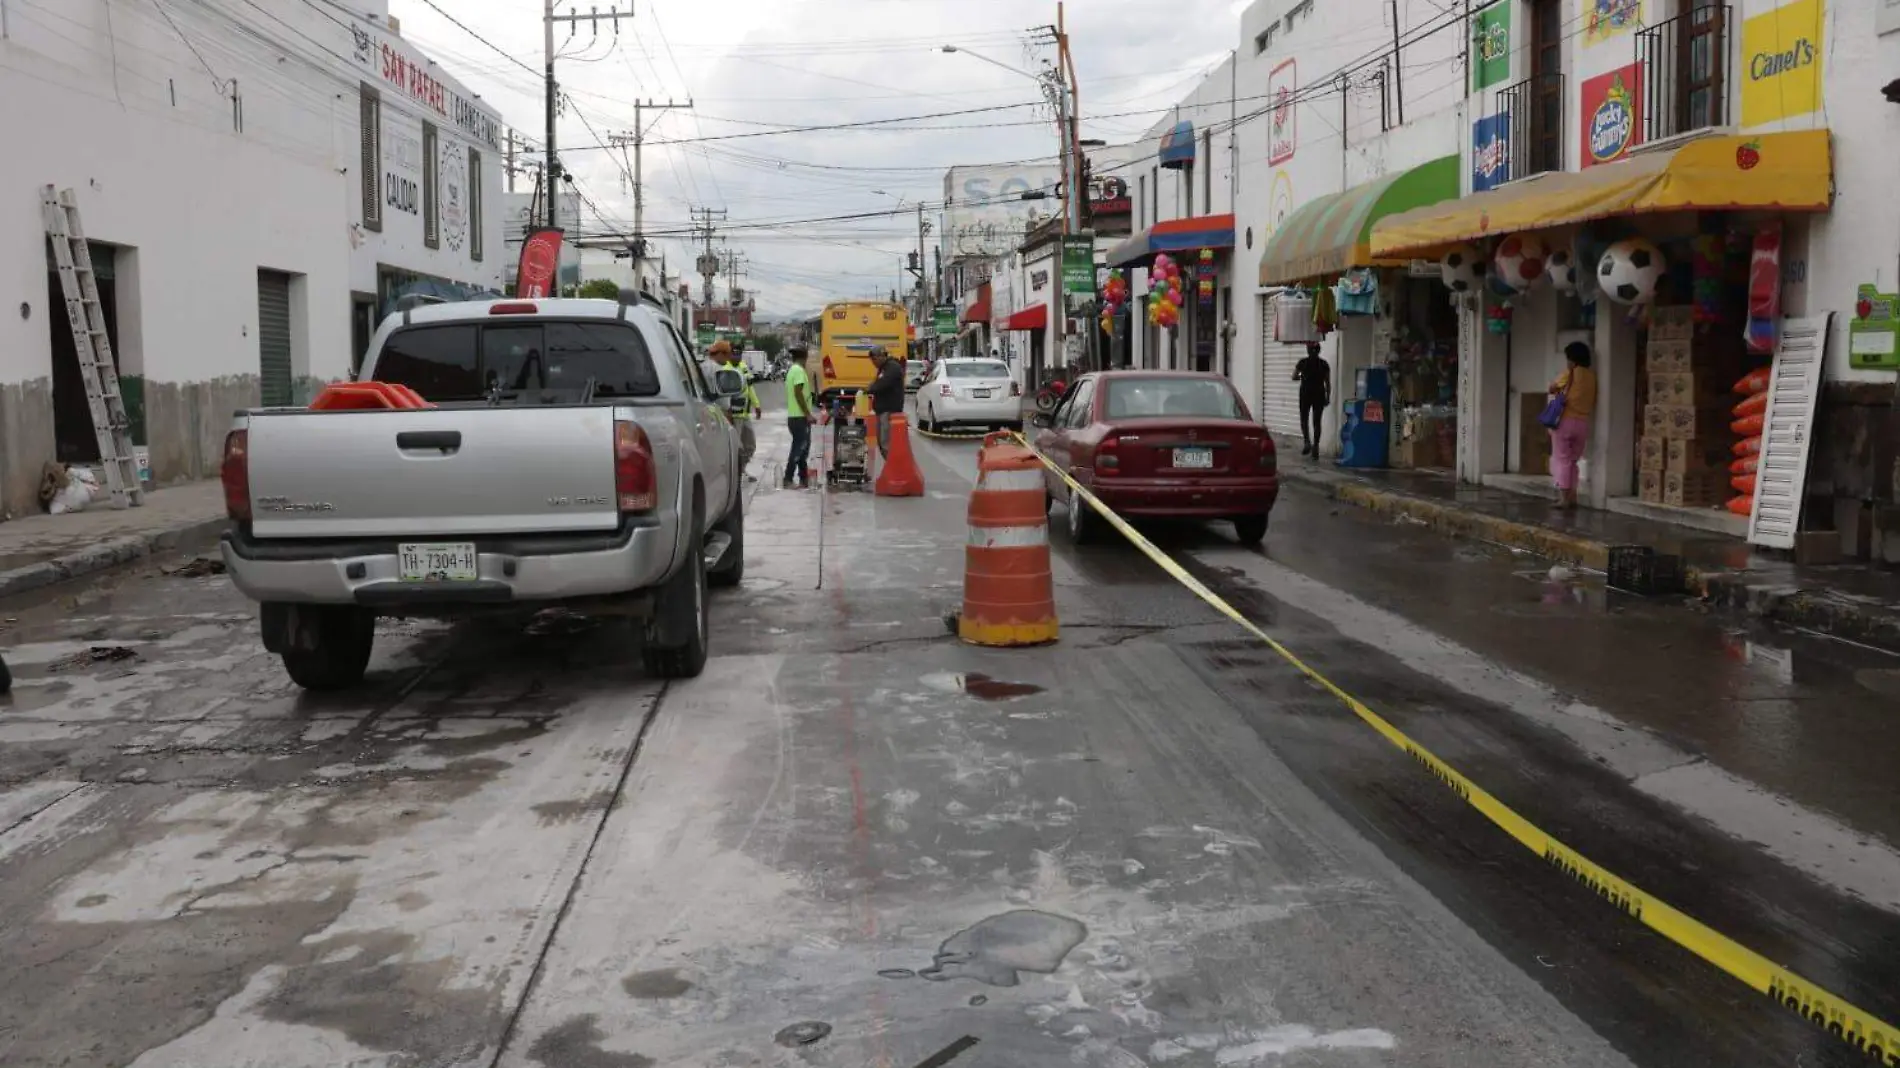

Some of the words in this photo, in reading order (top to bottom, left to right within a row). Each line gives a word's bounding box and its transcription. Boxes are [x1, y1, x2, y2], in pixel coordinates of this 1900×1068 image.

[381, 43, 406, 89] SAN
[409, 61, 447, 117] RAFAEL
[1751, 37, 1813, 81] Canel's
[1595, 103, 1622, 134] Lucky
[386, 171, 418, 216] CALIDAD
[401, 552, 474, 570] TH-7304-H
